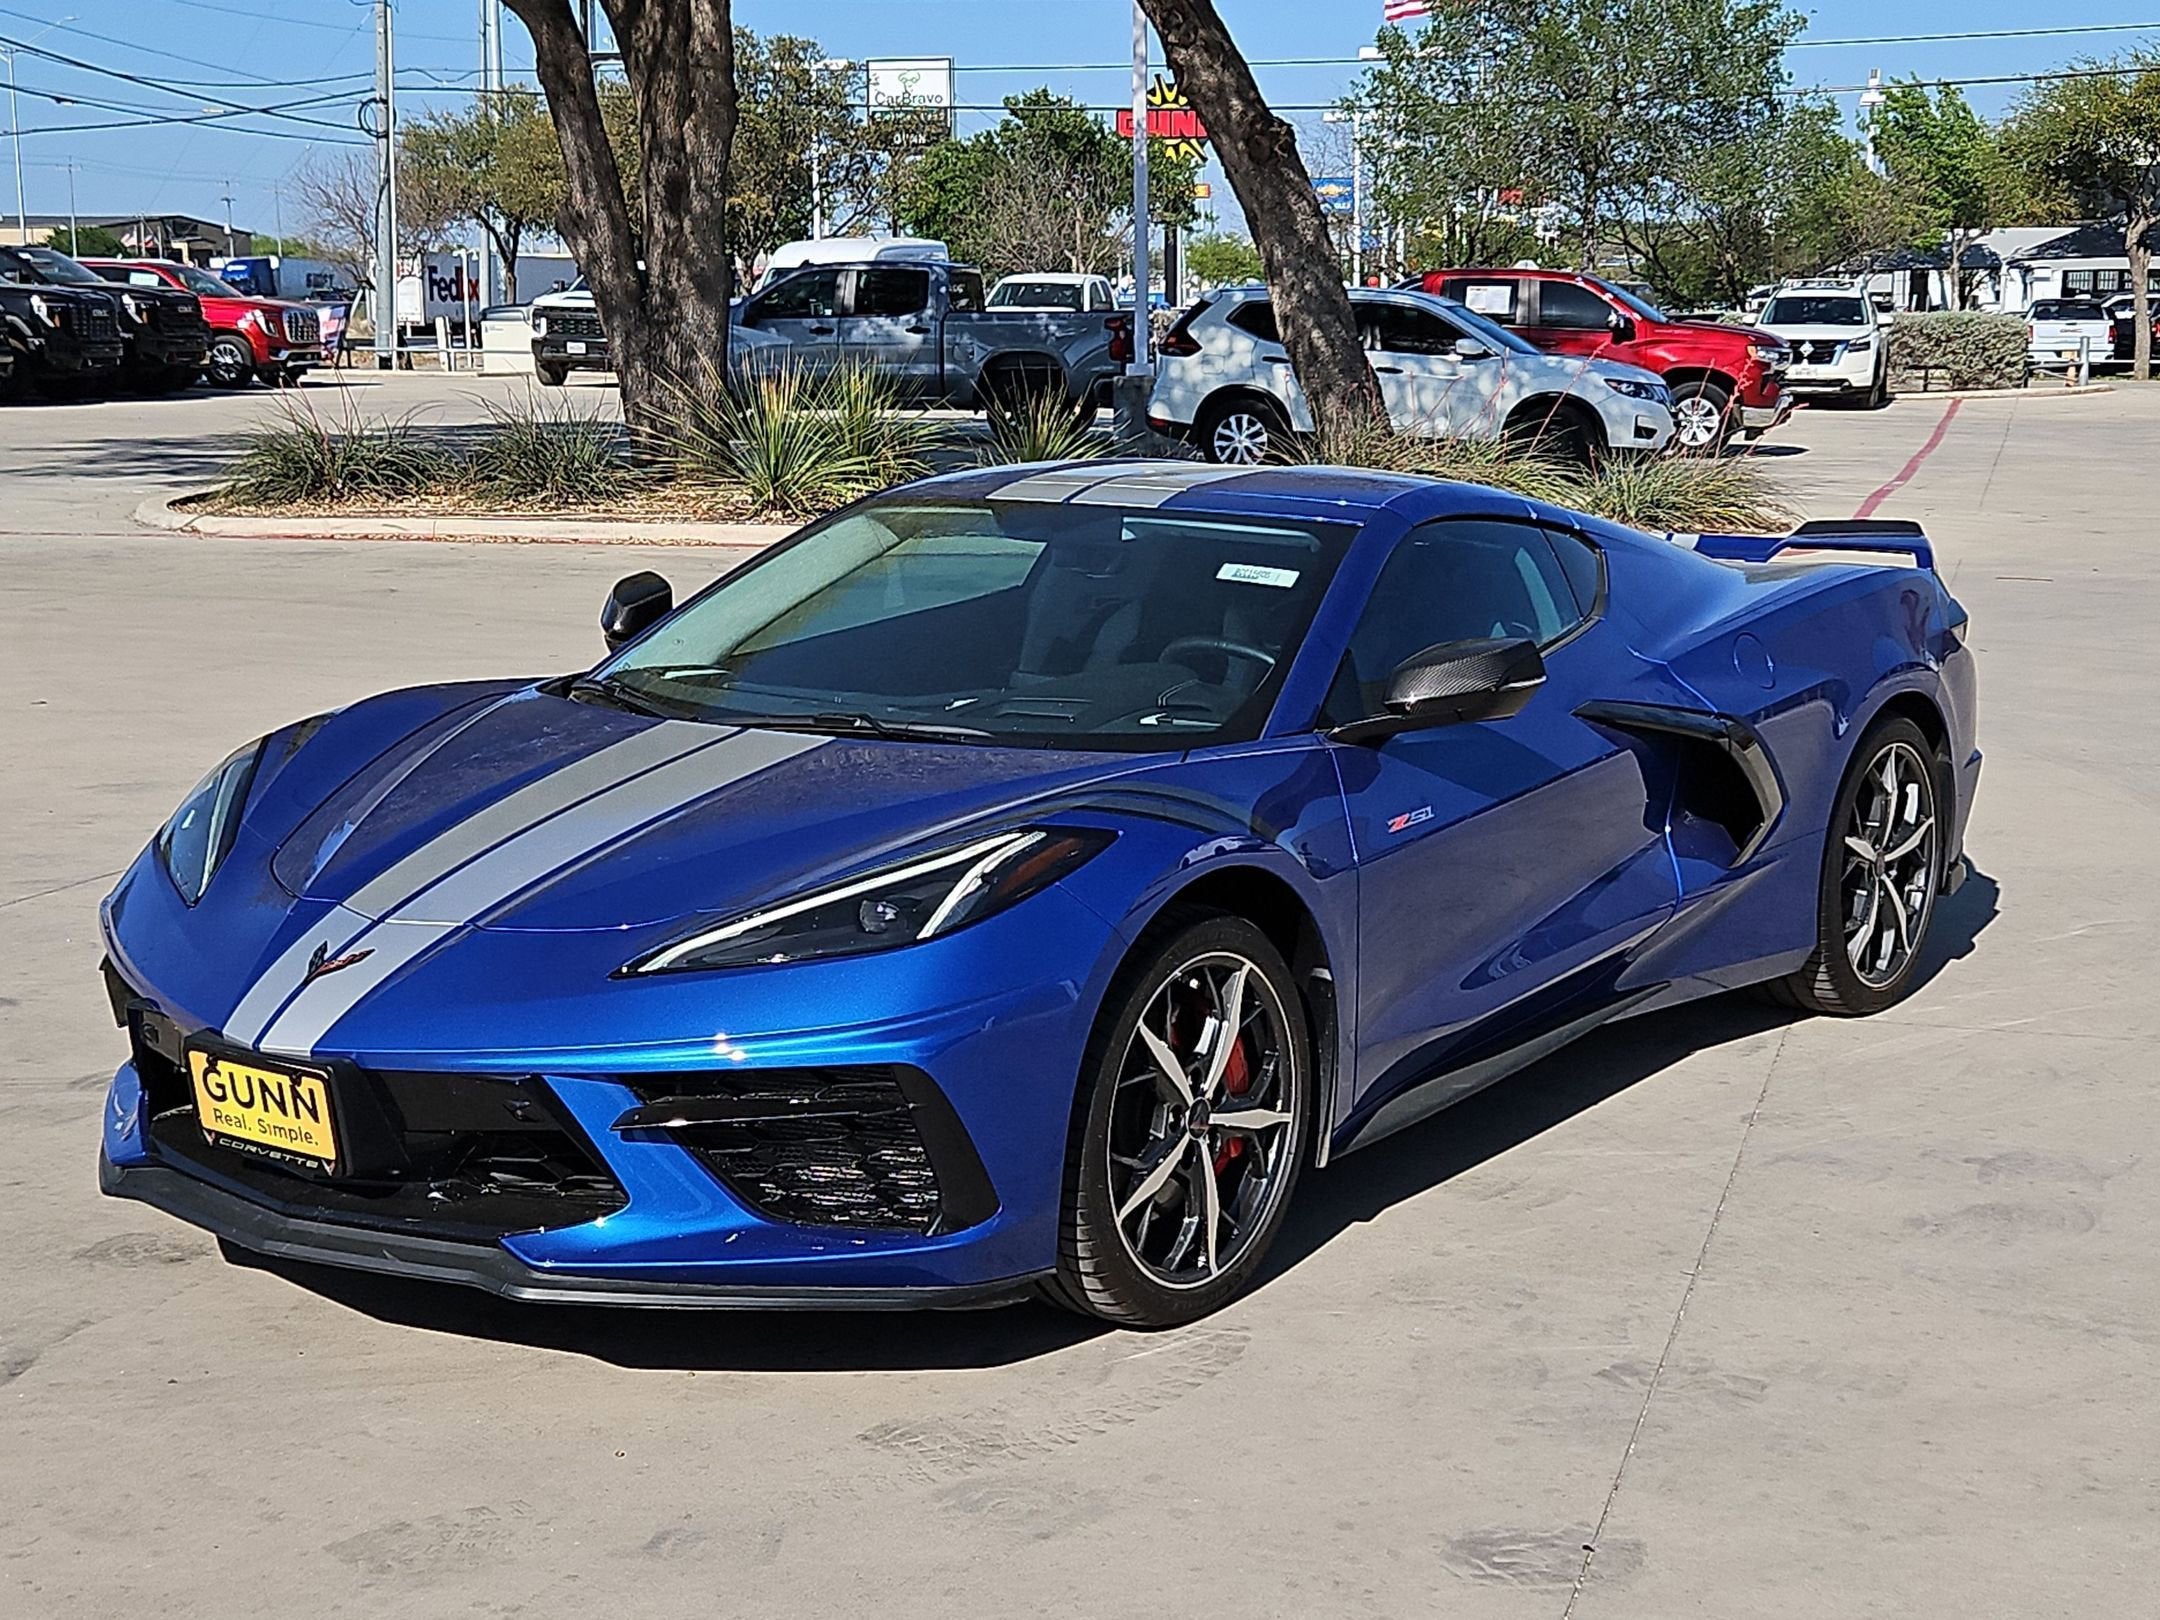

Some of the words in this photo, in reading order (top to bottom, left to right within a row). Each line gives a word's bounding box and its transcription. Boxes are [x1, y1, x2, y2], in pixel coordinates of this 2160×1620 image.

[875, 91, 943, 105] CarBravo
[1386, 805, 1435, 834] Z51
[202, 1065, 321, 1124] GUNN
[212, 1107, 252, 1132] Real.
[257, 1118, 319, 1146] Simple.
[219, 1137, 319, 1169] CORVETTE
